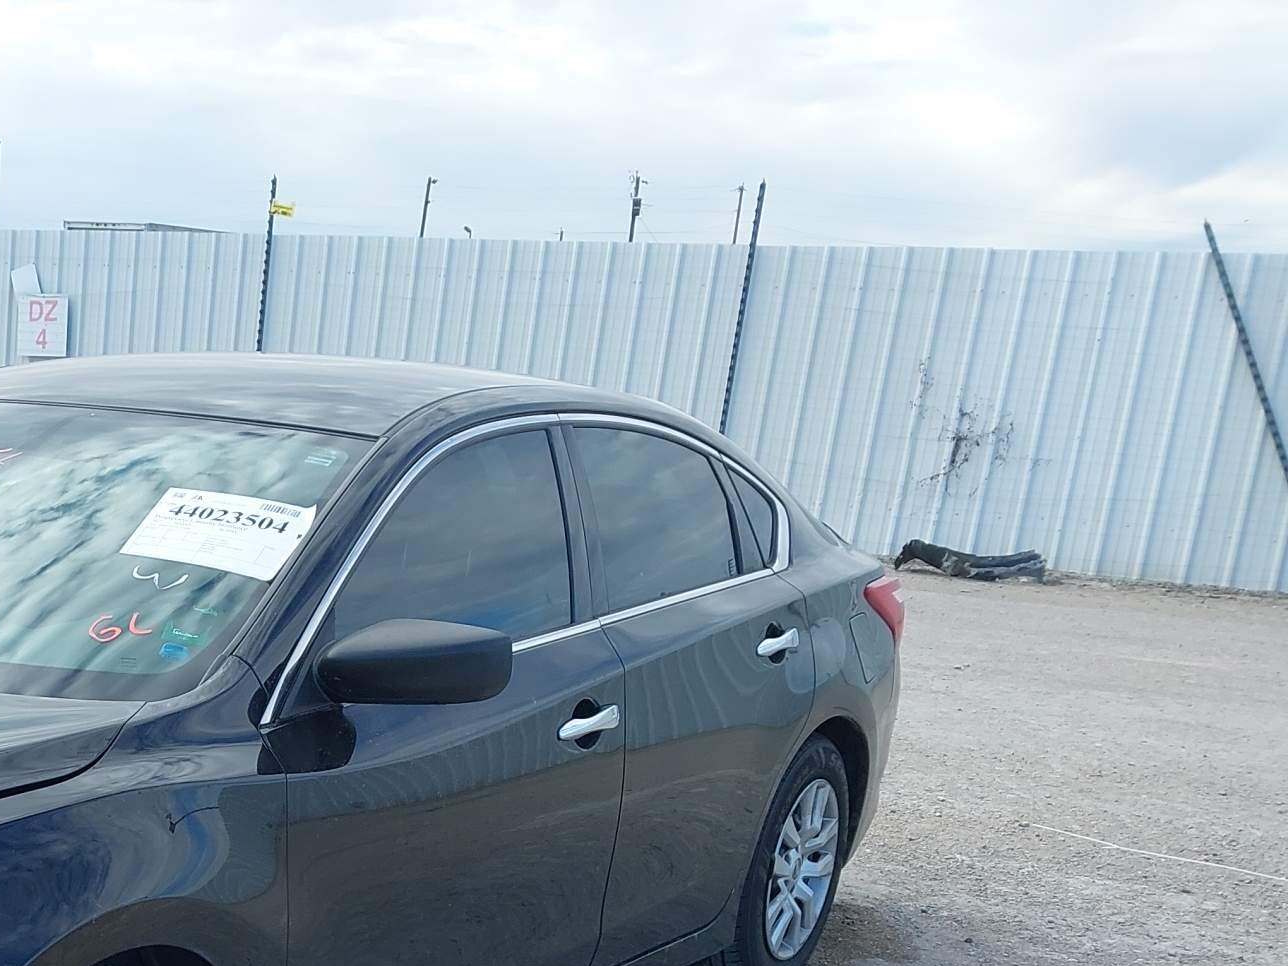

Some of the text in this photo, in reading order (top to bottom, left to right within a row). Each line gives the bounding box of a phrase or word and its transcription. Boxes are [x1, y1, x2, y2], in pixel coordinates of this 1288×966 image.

[29, 300, 59, 322] DZ
[35, 328, 48, 349] 4
[168, 503, 290, 534] 44023504
